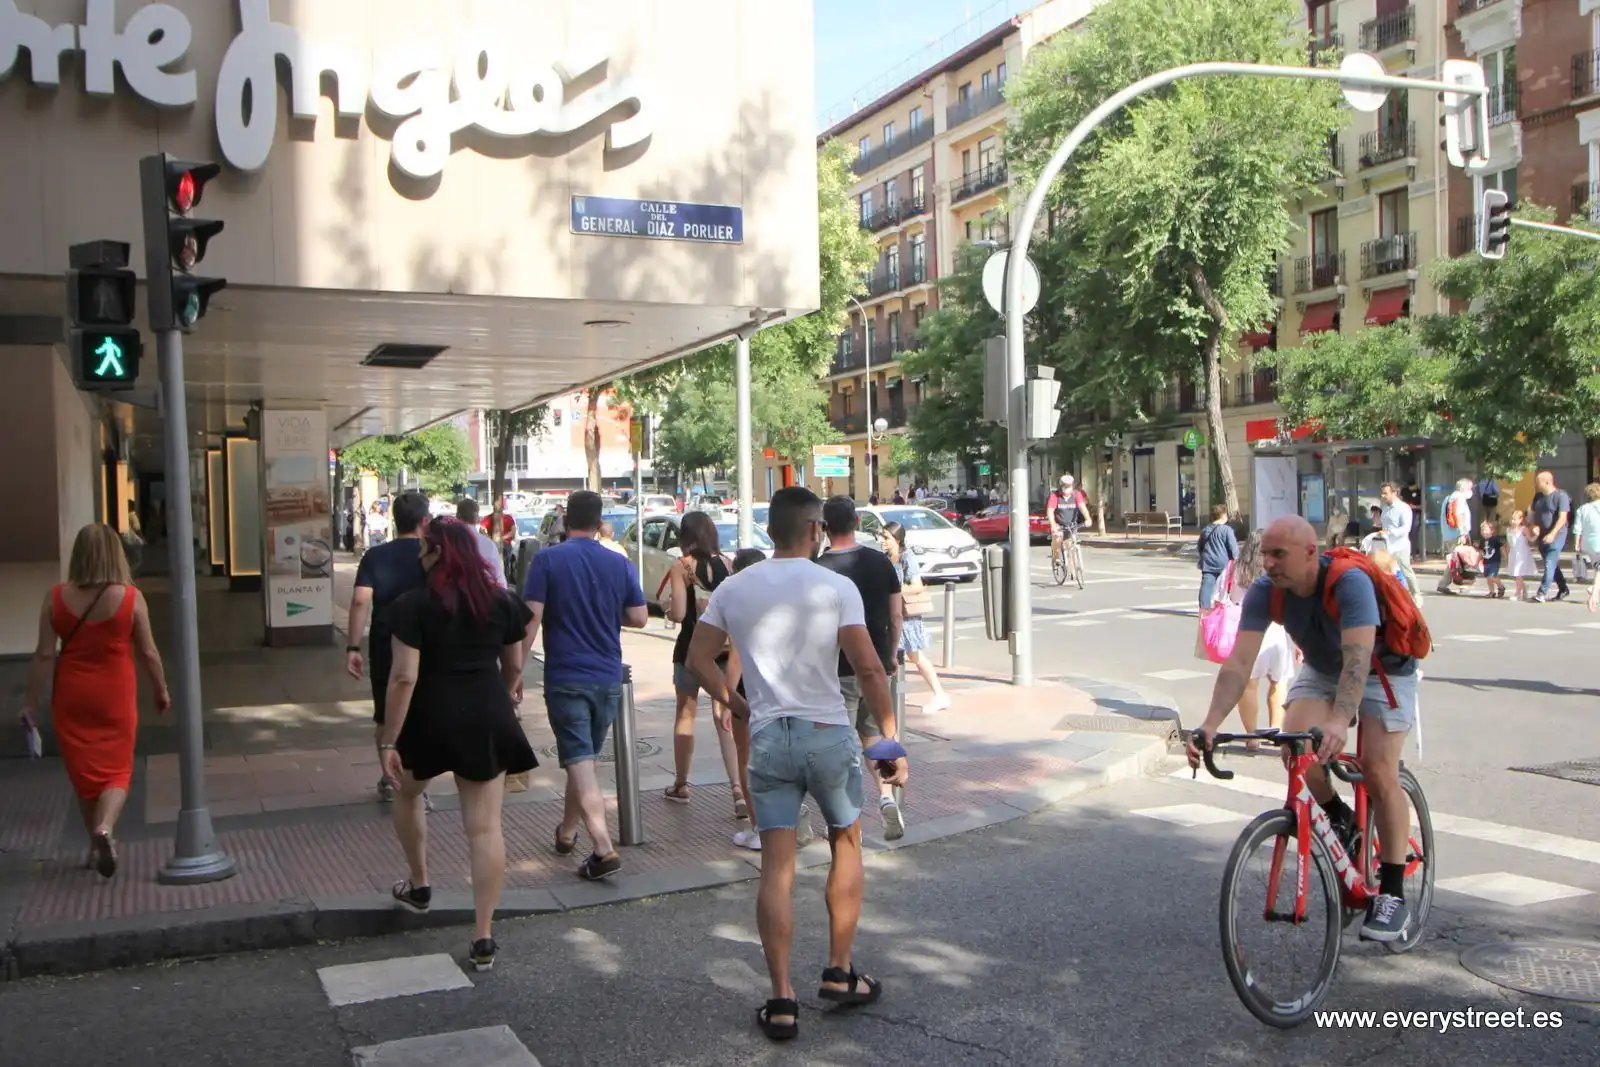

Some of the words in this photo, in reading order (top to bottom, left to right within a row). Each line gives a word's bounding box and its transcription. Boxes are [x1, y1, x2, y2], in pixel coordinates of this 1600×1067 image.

[640, 202, 678, 215] CALLE
[650, 213, 667, 221] DEL
[581, 216, 638, 234] GENERAL
[647, 221, 675, 237] DIAZ
[683, 223, 734, 240] PORLIER
[1297, 853, 1305, 897] TREK
